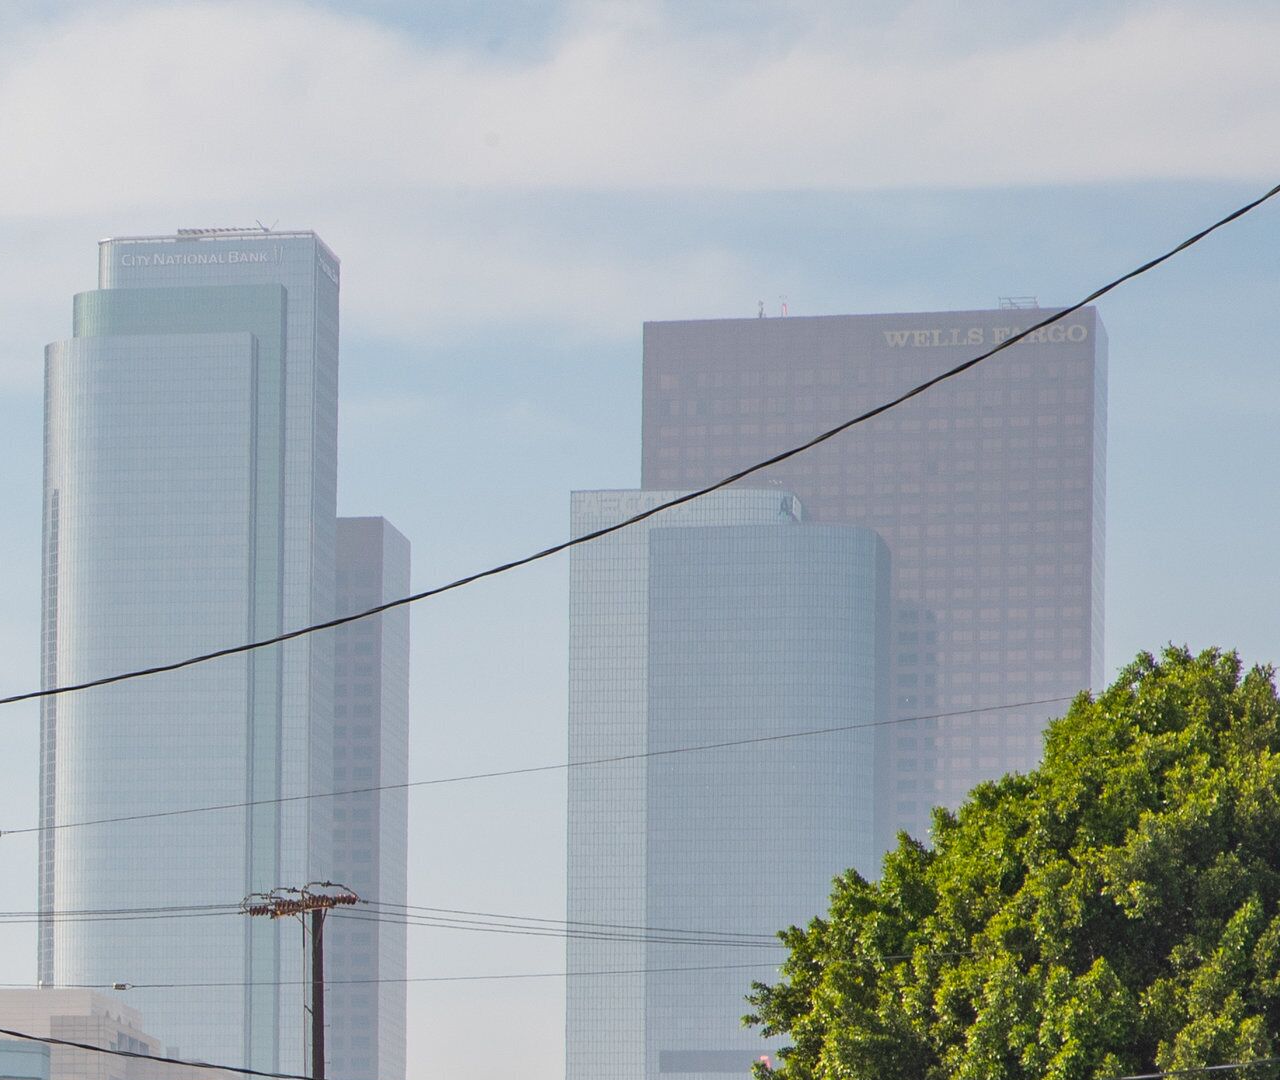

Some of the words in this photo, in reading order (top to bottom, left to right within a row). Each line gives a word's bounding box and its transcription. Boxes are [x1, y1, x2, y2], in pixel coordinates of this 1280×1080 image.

[228, 250, 269, 264] BANK
[884, 328, 984, 347] WELLS
[992, 324, 1088, 345] FARGO
